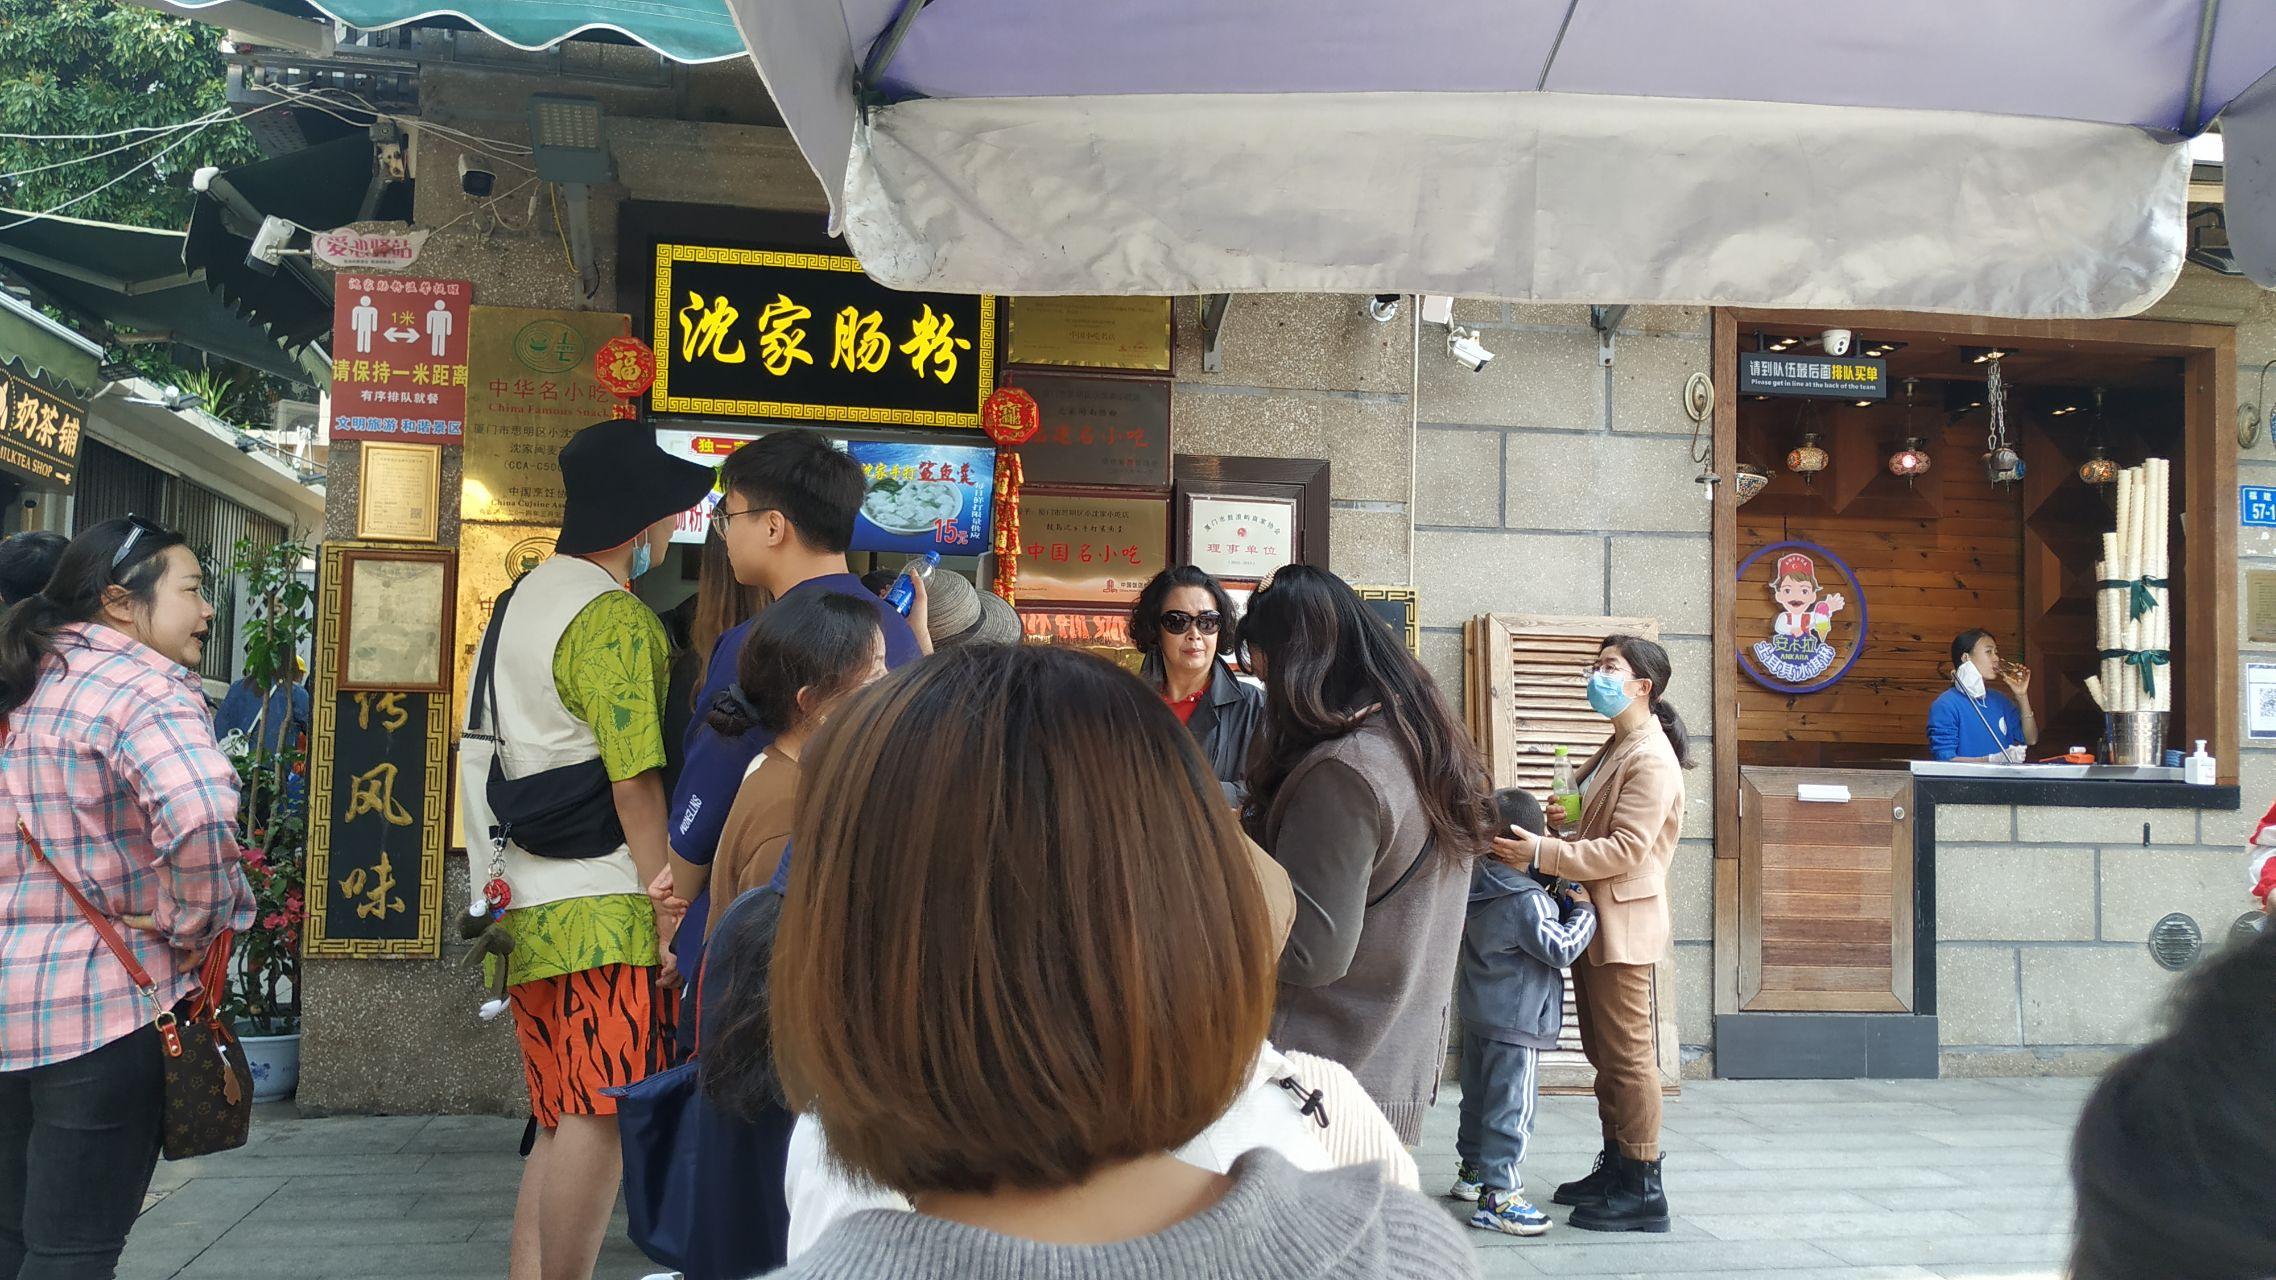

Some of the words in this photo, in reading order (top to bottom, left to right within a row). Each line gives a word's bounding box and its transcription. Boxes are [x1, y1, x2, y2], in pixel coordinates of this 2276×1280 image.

[391, 310, 416, 326] 1米
[679, 290, 972, 384] 沈家肠粉
[332, 359, 468, 388] 请保持一米距离
[609, 350, 642, 382] 福
[1750, 360, 1878, 382] 请到队伍最后面排队买单
[489, 377, 610, 403] 中华名小吃
[1773, 380, 1784, 388] get
[1812, 380, 1824, 388] the
[1824, 381, 1839, 389] back
[1848, 382, 1859, 390] the
[361, 390, 439, 404] 有序排队就餐
[489, 402, 524, 414] China
[528, 404, 574, 416] Famous
[13, 392, 80, 458] 奶茶铺
[335, 415, 398, 433] 文明旅游
[401, 418, 462, 435] 和谐景区
[32, 459, 53, 478] SHOP
[934, 518, 969, 545] 15元
[1026, 542, 1142, 565] 中国名小吃
[1207, 543, 1277, 556] 理事单位
[1775, 636, 1817, 653] 安卡拉
[1755, 642, 1835, 681] 土耳其冰淇淋
